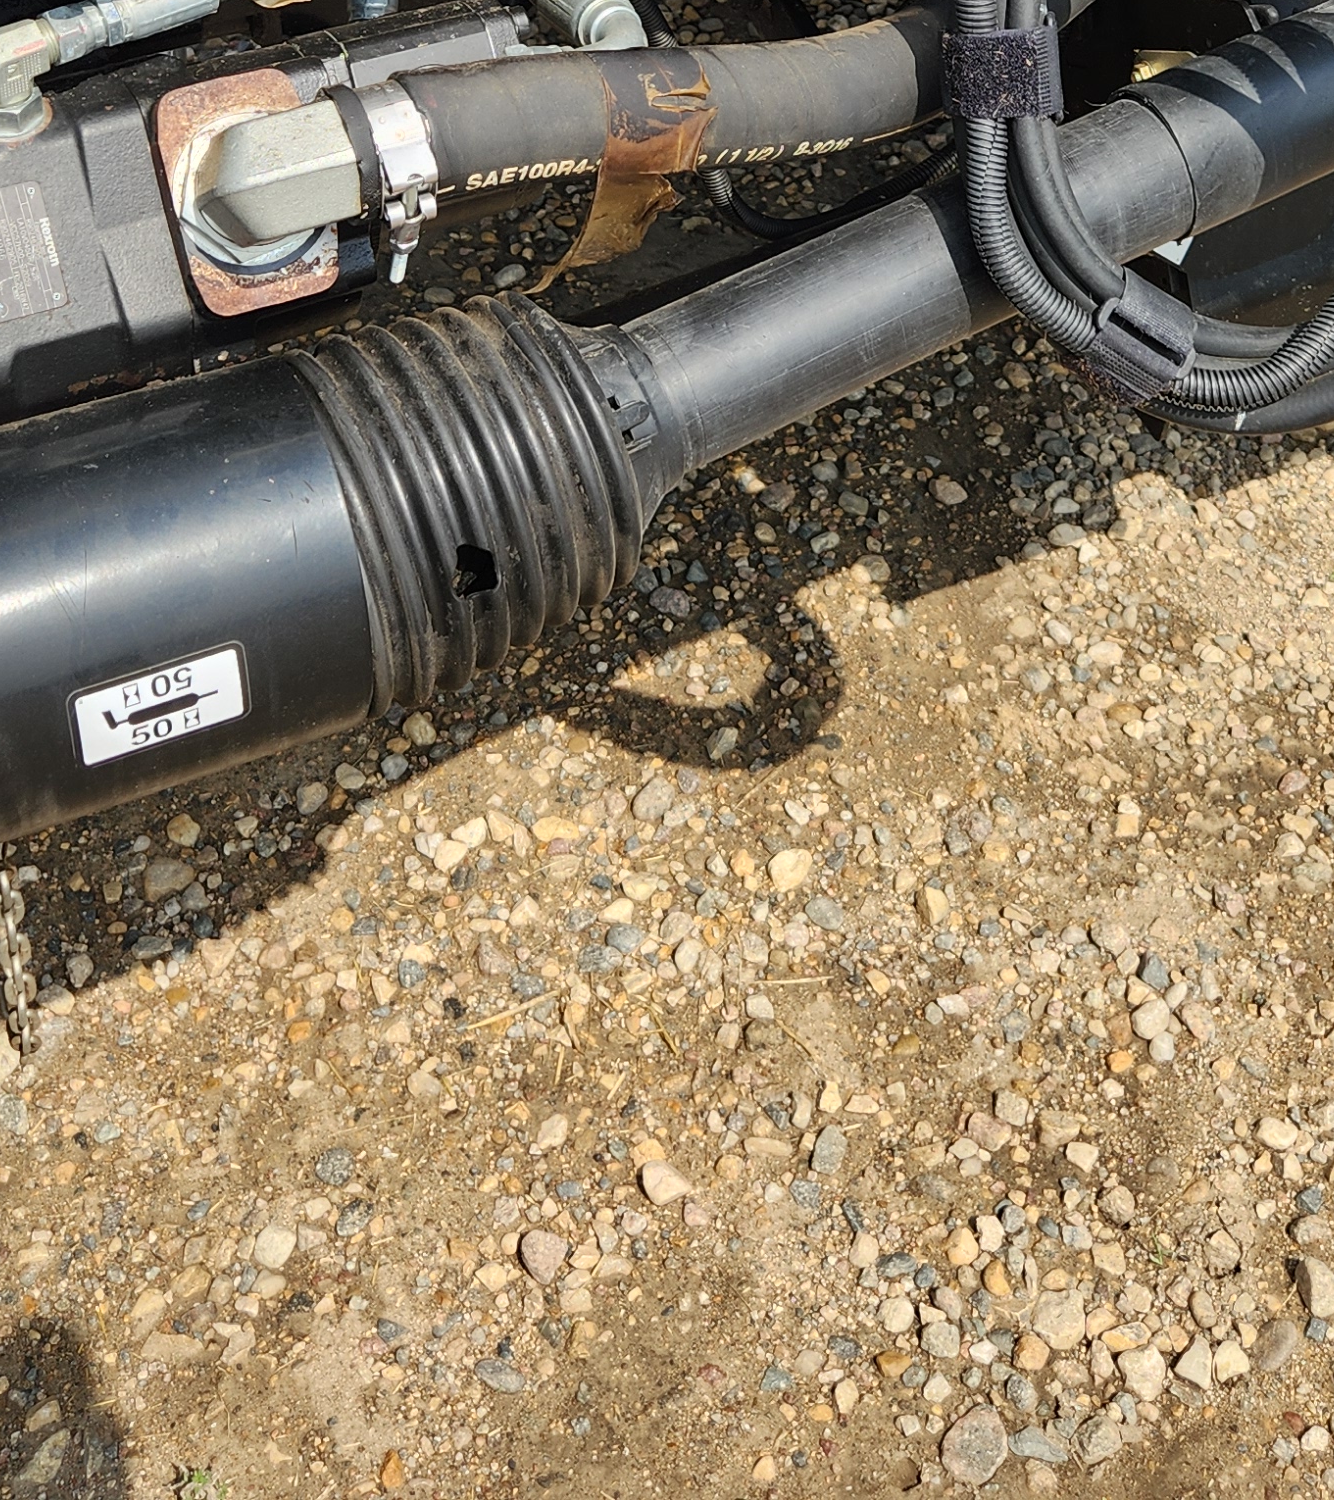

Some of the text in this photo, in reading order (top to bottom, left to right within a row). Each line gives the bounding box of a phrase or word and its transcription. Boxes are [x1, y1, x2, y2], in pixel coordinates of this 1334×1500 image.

[39, 217, 59, 268] Rexroth
[150, 666, 193, 698] 50
[130, 718, 173, 746] 50
